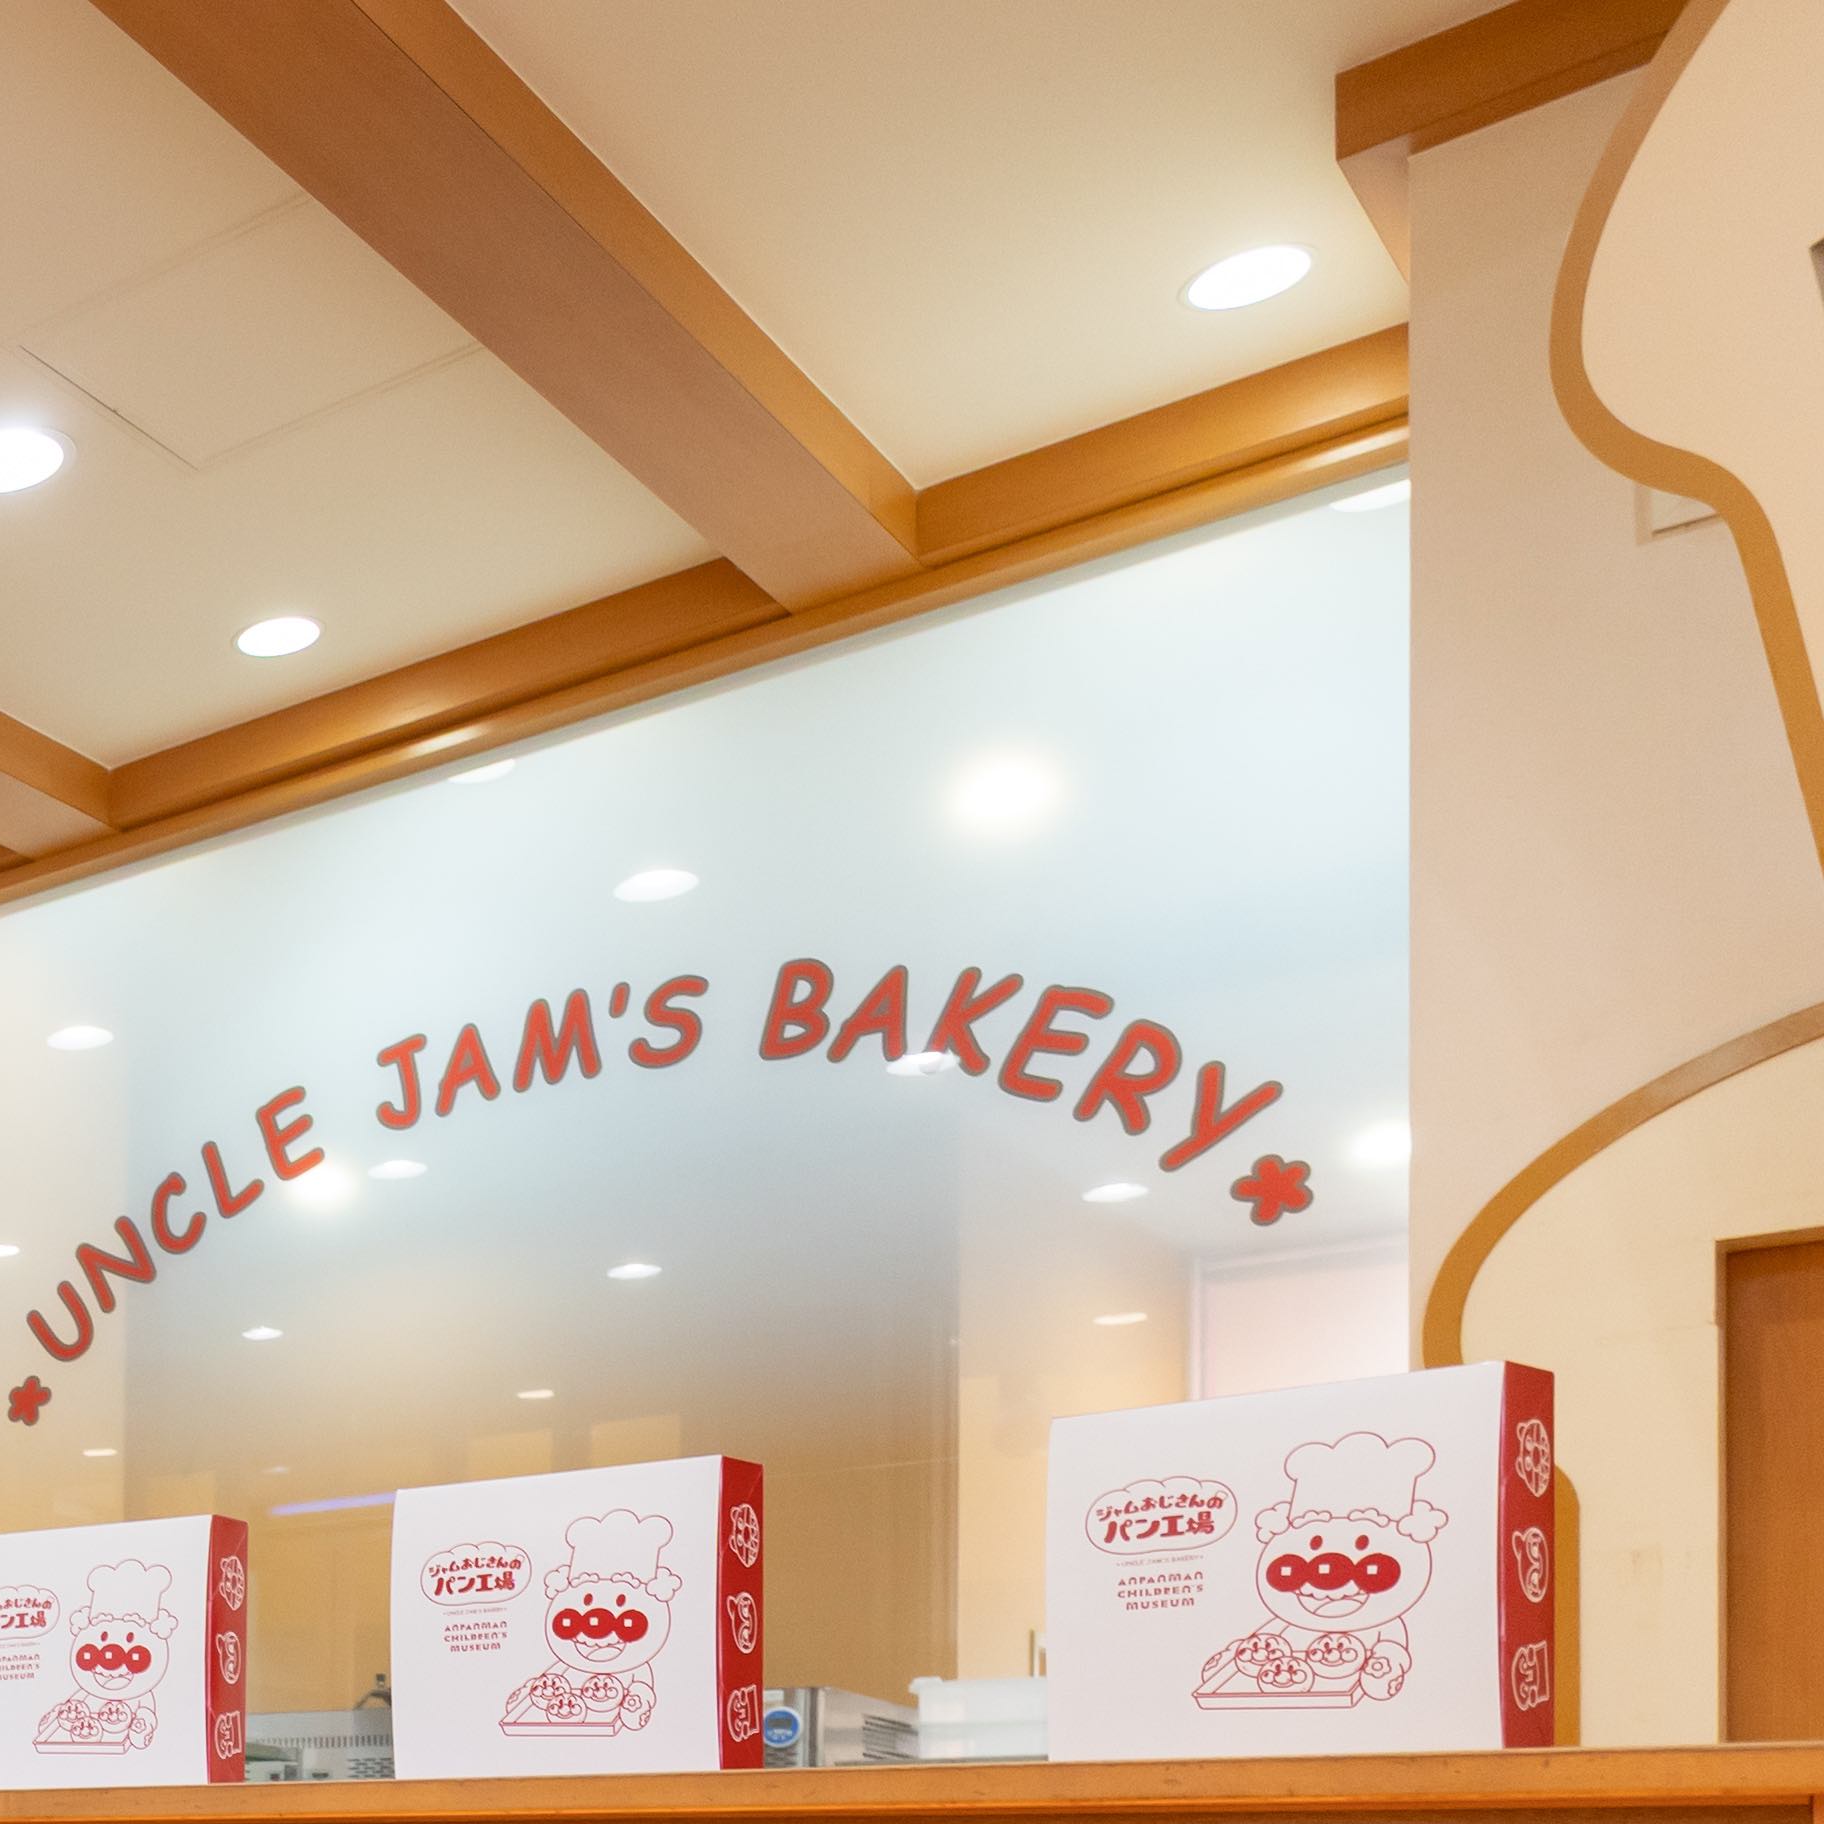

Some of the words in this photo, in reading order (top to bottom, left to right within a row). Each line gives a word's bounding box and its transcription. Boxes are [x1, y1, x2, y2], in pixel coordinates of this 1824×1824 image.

[27, 1085, 324, 1361] UNCLE
[375, 976, 708, 1130] JAM'S
[759, 959, 1283, 1173] BAKERY
[1096, 1494, 1224, 1521] ジャムおじさんの
[1104, 1511, 1215, 1543] パン工場
[429, 1556, 521, 1577] ジャムおじさんの
[434, 1571, 515, 1596] パン工場
[1118, 1571, 1203, 1586] ANPANMAN
[1117, 1584, 1204, 1599] CHILDREN'S
[1126, 1597, 1195, 1611] MUSEUM
[444, 1621, 507, 1632] ANPANMAN
[444, 1632, 507, 1642] CHILDREN'S
[450, 1643, 501, 1652] MUSEUM
